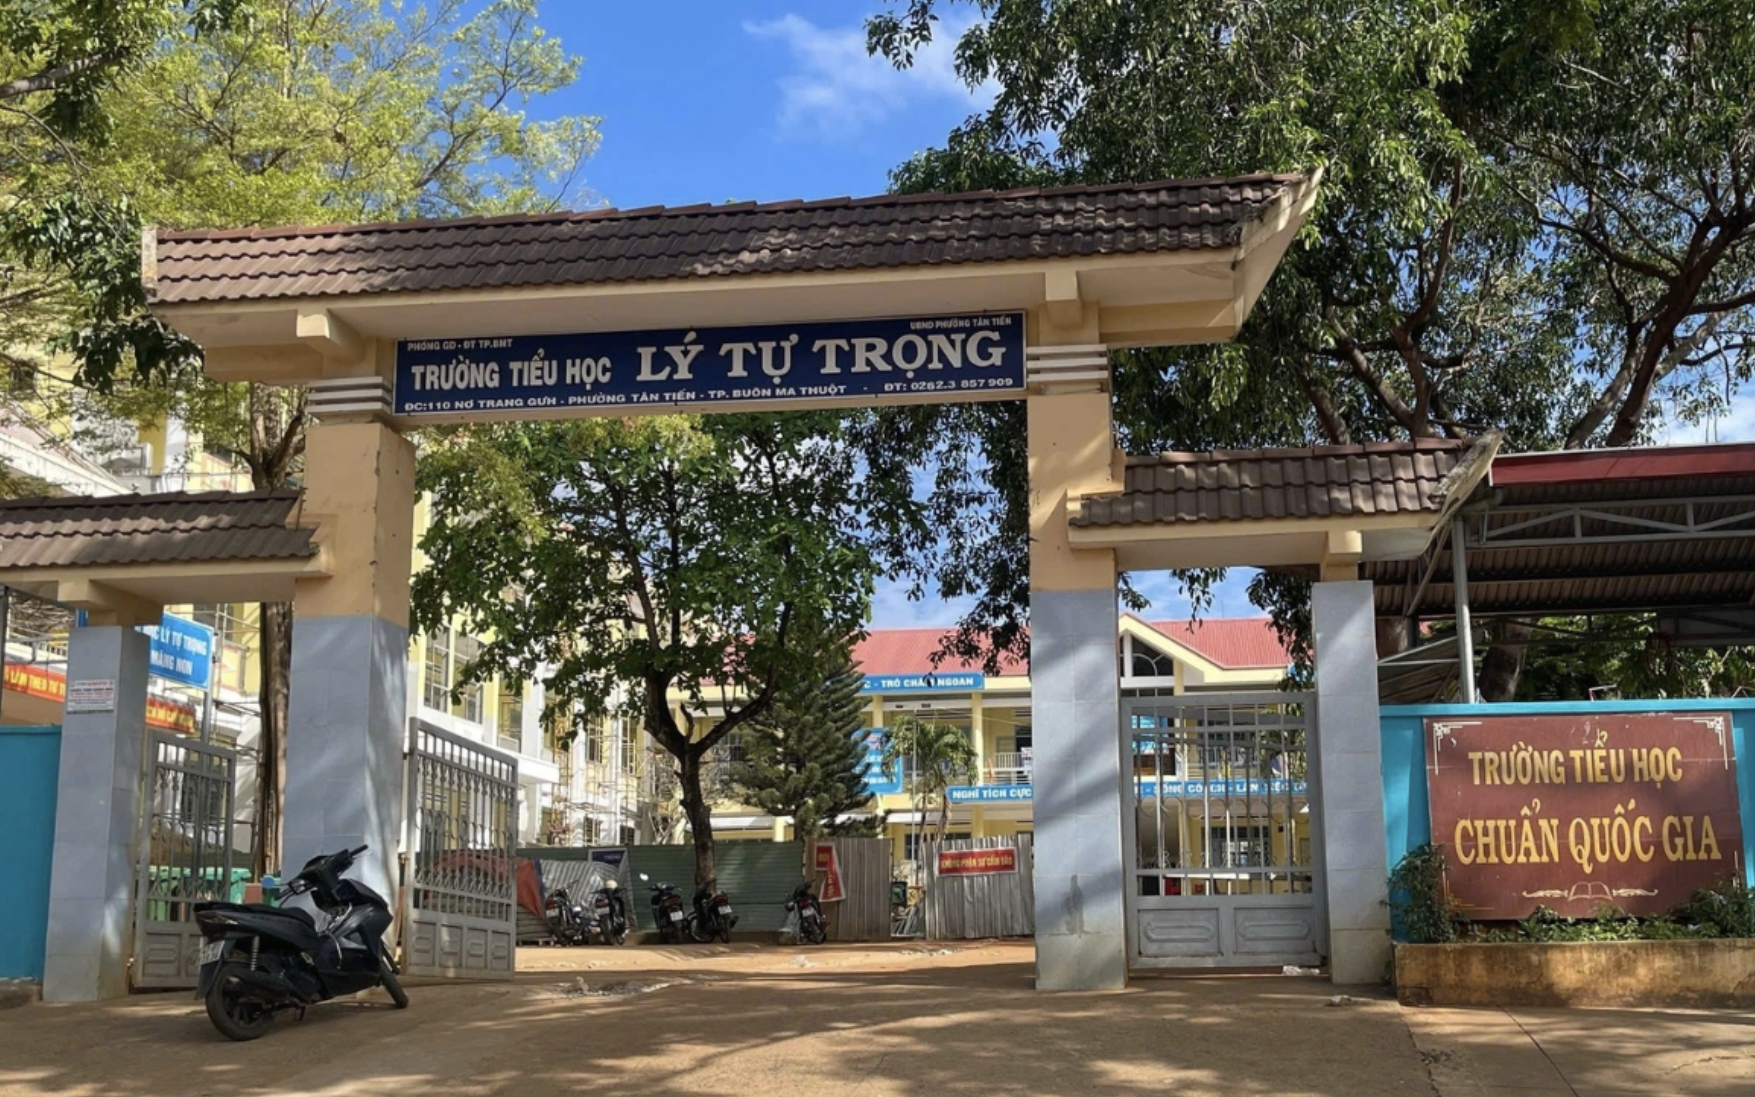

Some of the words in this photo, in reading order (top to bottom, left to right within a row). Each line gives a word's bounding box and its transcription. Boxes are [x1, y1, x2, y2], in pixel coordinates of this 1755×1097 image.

[910, 321, 934, 330] UBND
[935, 318, 971, 329] PHƯỜNG
[972, 317, 990, 327] TÂN
[991, 314, 1012, 326] TIẾN
[411, 355, 499, 391] TRƯỜNG
[509, 348, 557, 387] TIỂU
[565, 356, 612, 390] HỌC
[636, 330, 704, 381] LÝ
[718, 333, 799, 385] TỰ
[811, 330, 1007, 379] TRỌNG
[454, 399, 474, 409] NƠ
[477, 399, 524, 408] TRANG
[568, 391, 626, 405] PHƯỜNG
[631, 391, 659, 401] TÂN
[663, 388, 696, 400] TIẾN
[707, 390, 729, 398] TP.
[732, 387, 771, 398] BUÔN
[775, 387, 796, 396] MA
[799, 383, 847, 396] THUỘT
[884, 382, 907, 391] ĐT:
[961, 379, 986, 388] 857
[988, 377, 1013, 387] 909
[937, 677, 974, 687] NGOAN
[1468, 741, 1566, 785] TRƯỜNG
[1569, 730, 1625, 784] TIỂU
[1632, 747, 1683, 789] HỌC
[1454, 798, 1559, 865] CHUẨN
[1568, 798, 1654, 874] QUỐC
[1662, 815, 1722, 861] GIA
